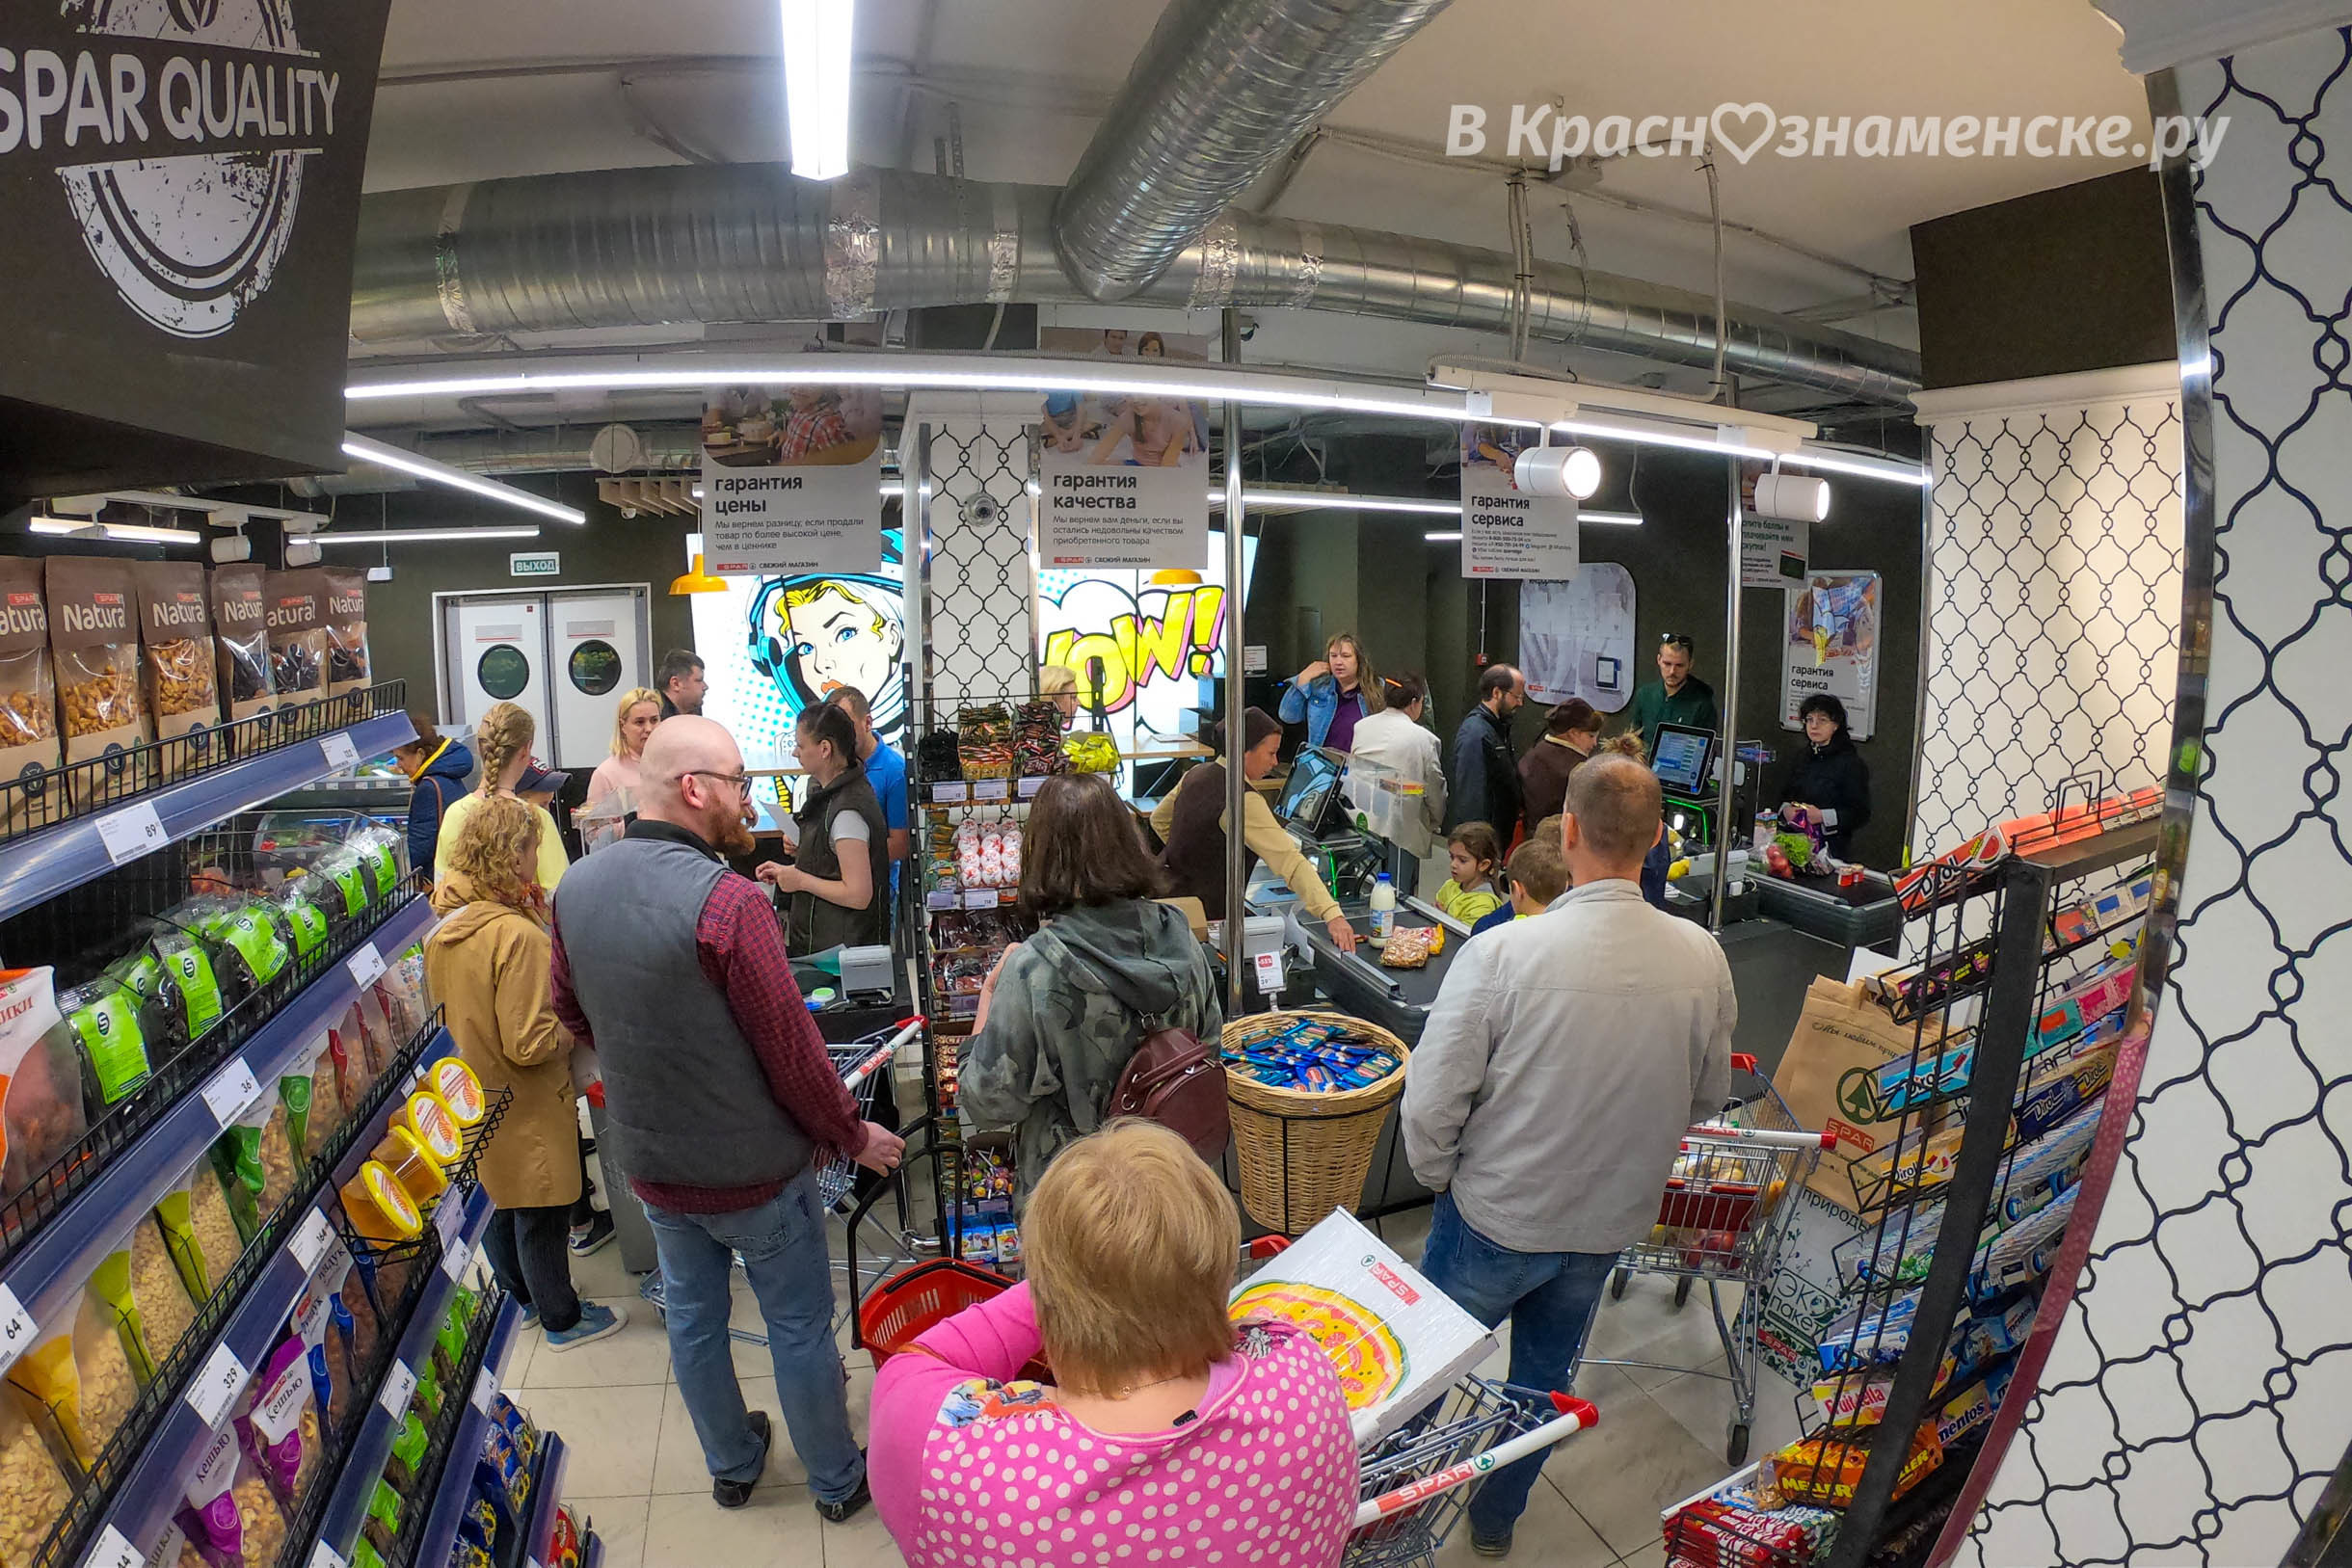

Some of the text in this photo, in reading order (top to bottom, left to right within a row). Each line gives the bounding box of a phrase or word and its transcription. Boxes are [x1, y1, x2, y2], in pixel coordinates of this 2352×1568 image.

[0, 47, 339, 154] SPAR QUALITY
[715, 476, 803, 495] гарантия
[1053, 474, 1137, 491] гарантия
[715, 499, 767, 516] цены
[1054, 495, 1137, 510] качества
[1471, 495, 1530, 510] гарантия
[715, 520, 730, 529] Мы
[827, 518, 864, 526] продали
[1053, 516, 1067, 524] Мы
[1471, 514, 1524, 528] сервиса
[715, 532, 740, 541] товар
[755, 530, 781, 539] более
[782, 529, 818, 538] высокой
[1053, 526, 1089, 535] остались
[1091, 527, 1140, 536] недовольны
[741, 542, 778, 551] ценнике
[1122, 538, 1150, 546] товара
[516, 561, 555, 572] ВЫХОД
[152, 600, 205, 626] Natural
[267, 601, 316, 626] atural
[1792, 666, 1833, 677] гарантия
[1791, 678, 1829, 690] сервиса
[146, 824, 156, 837] 89
[866, 1046, 892, 1070] SPAR
[241, 1079, 253, 1093] 36
[1828, 1122, 1873, 1151] SPAR
[1371, 1264, 1409, 1296] SPAR
[6, 1318, 22, 1340] 64
[1765, 1336, 1797, 1362] SPAR
[223, 1368, 238, 1389] 329
[265, 1377, 303, 1424] Кешью
[1938, 1401, 1985, 1442] mentos
[196, 1433, 230, 1485] Кешью
[1399, 1462, 1473, 1502] SPAR
